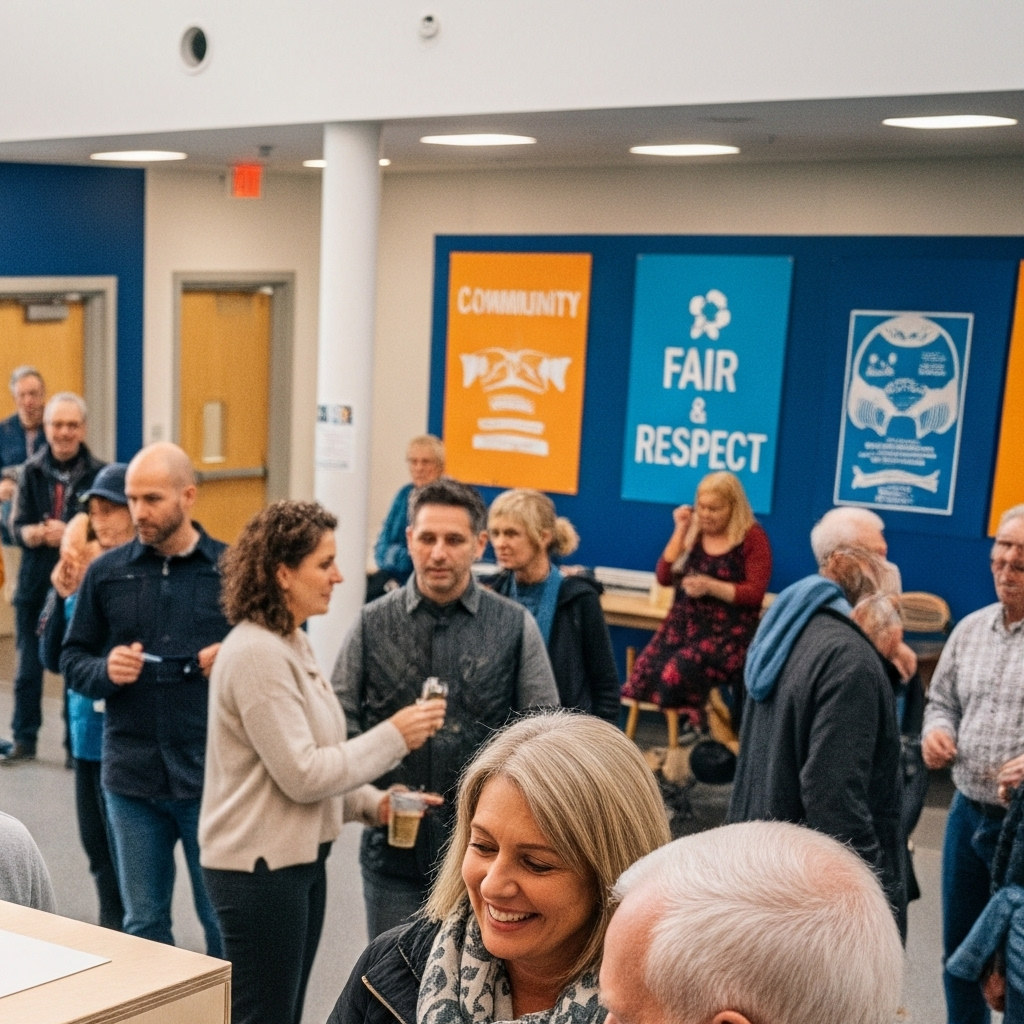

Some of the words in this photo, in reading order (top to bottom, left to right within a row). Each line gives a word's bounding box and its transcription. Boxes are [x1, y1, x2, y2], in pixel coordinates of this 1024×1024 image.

[457, 286, 581, 318] COMMUNITY
[663, 346, 739, 393] FAIR
[689, 396, 707, 424] &
[635, 424, 768, 473] RESPECT
